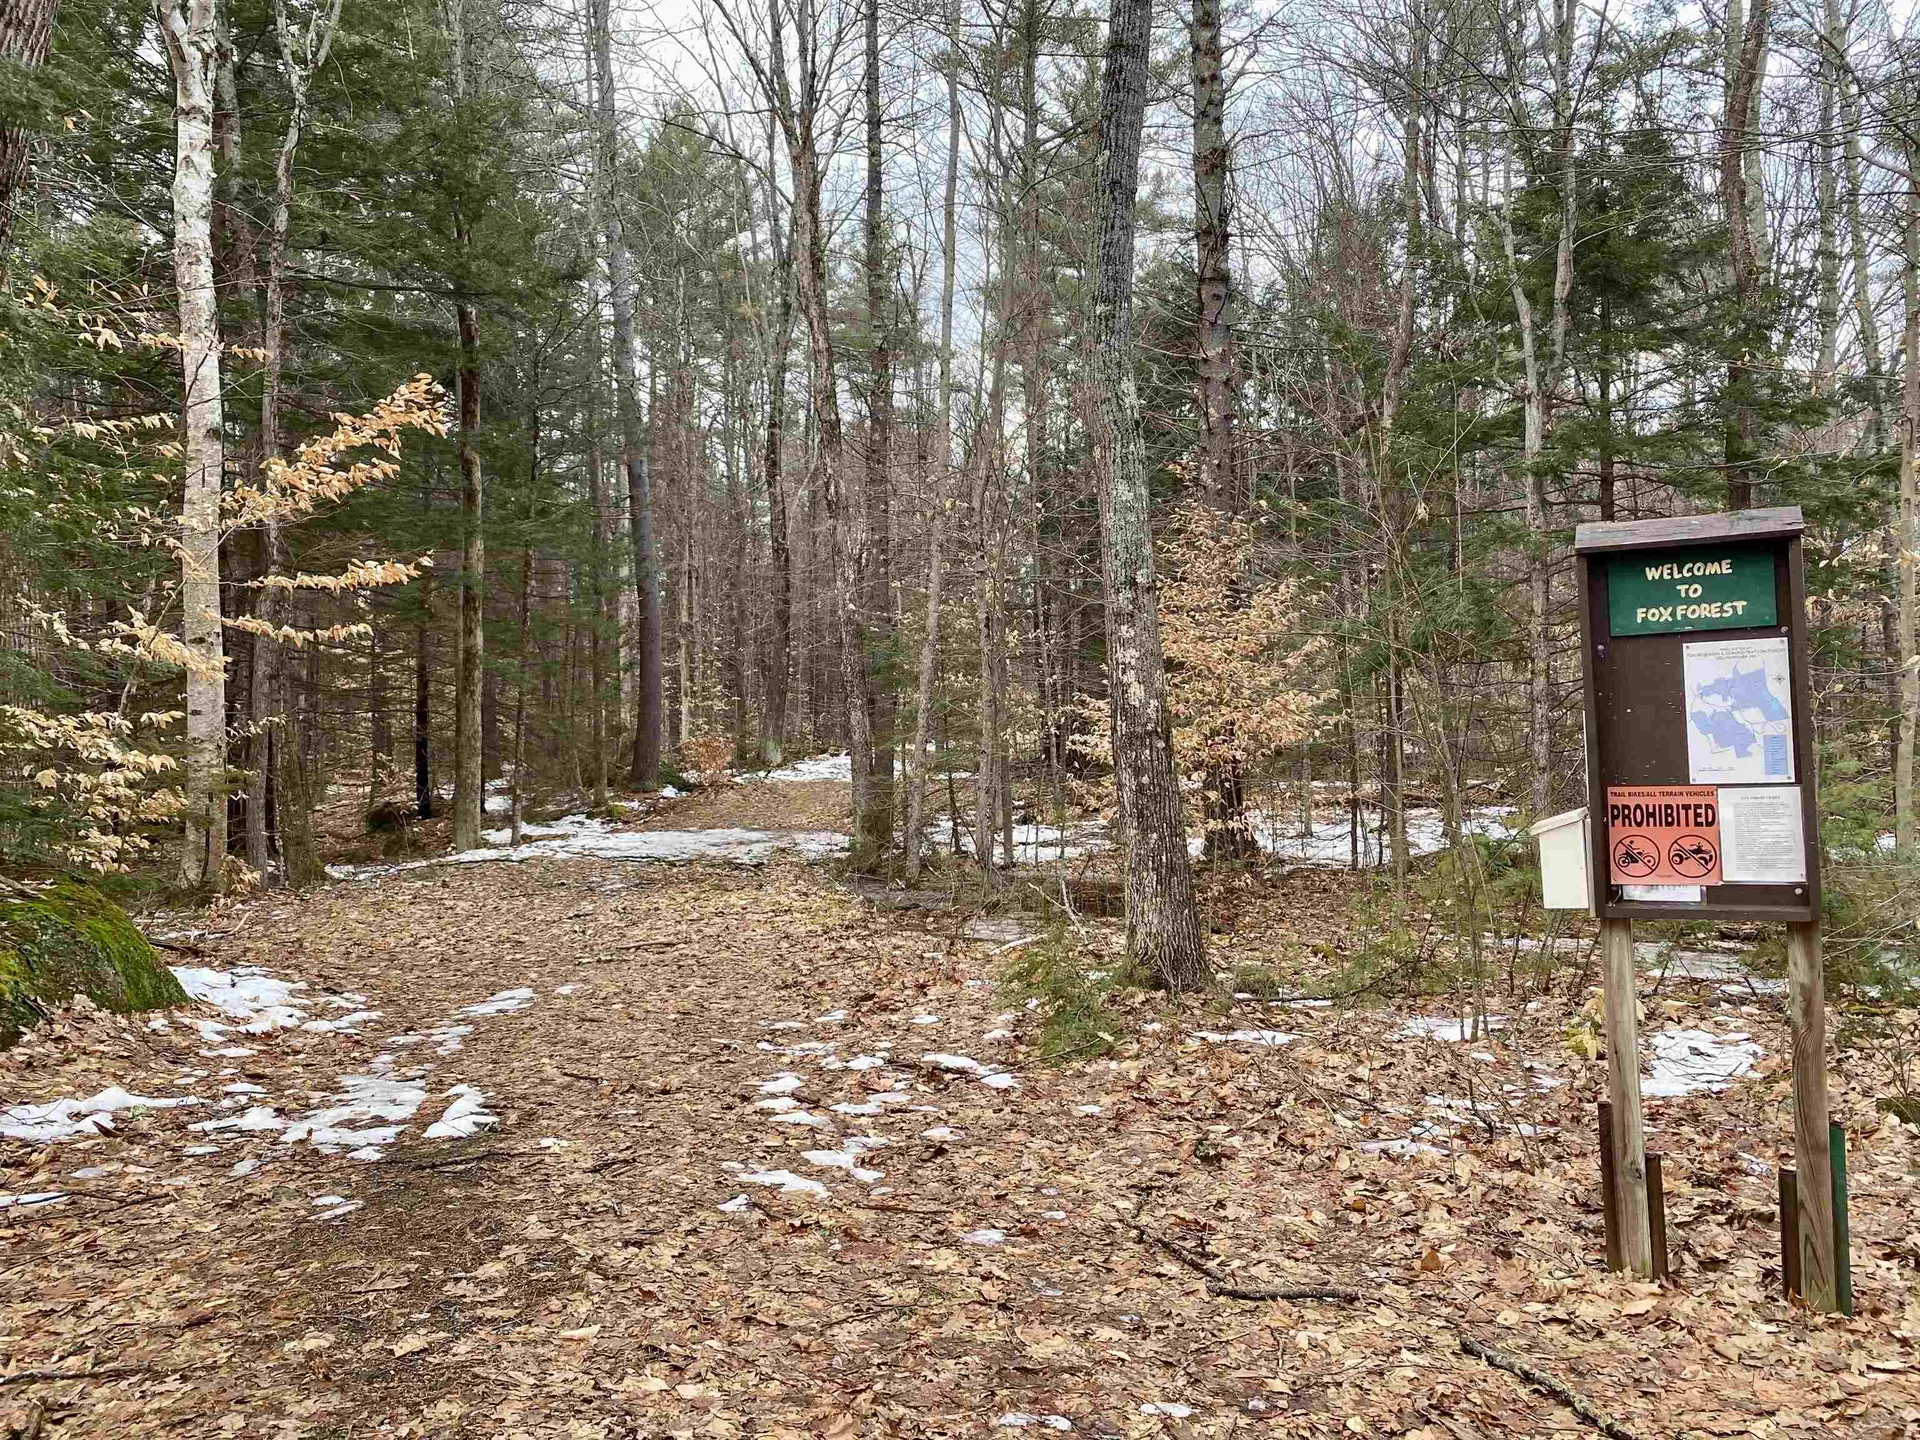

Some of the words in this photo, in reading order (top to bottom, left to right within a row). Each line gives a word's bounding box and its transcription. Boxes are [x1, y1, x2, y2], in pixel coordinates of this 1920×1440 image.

[1645, 559, 1733, 581] WELCOME
[1676, 583, 1703, 598] TO
[1636, 606, 1673, 624] FOX
[1676, 600, 1748, 621] FOREST
[1610, 803, 1716, 828] PROHIBITED
